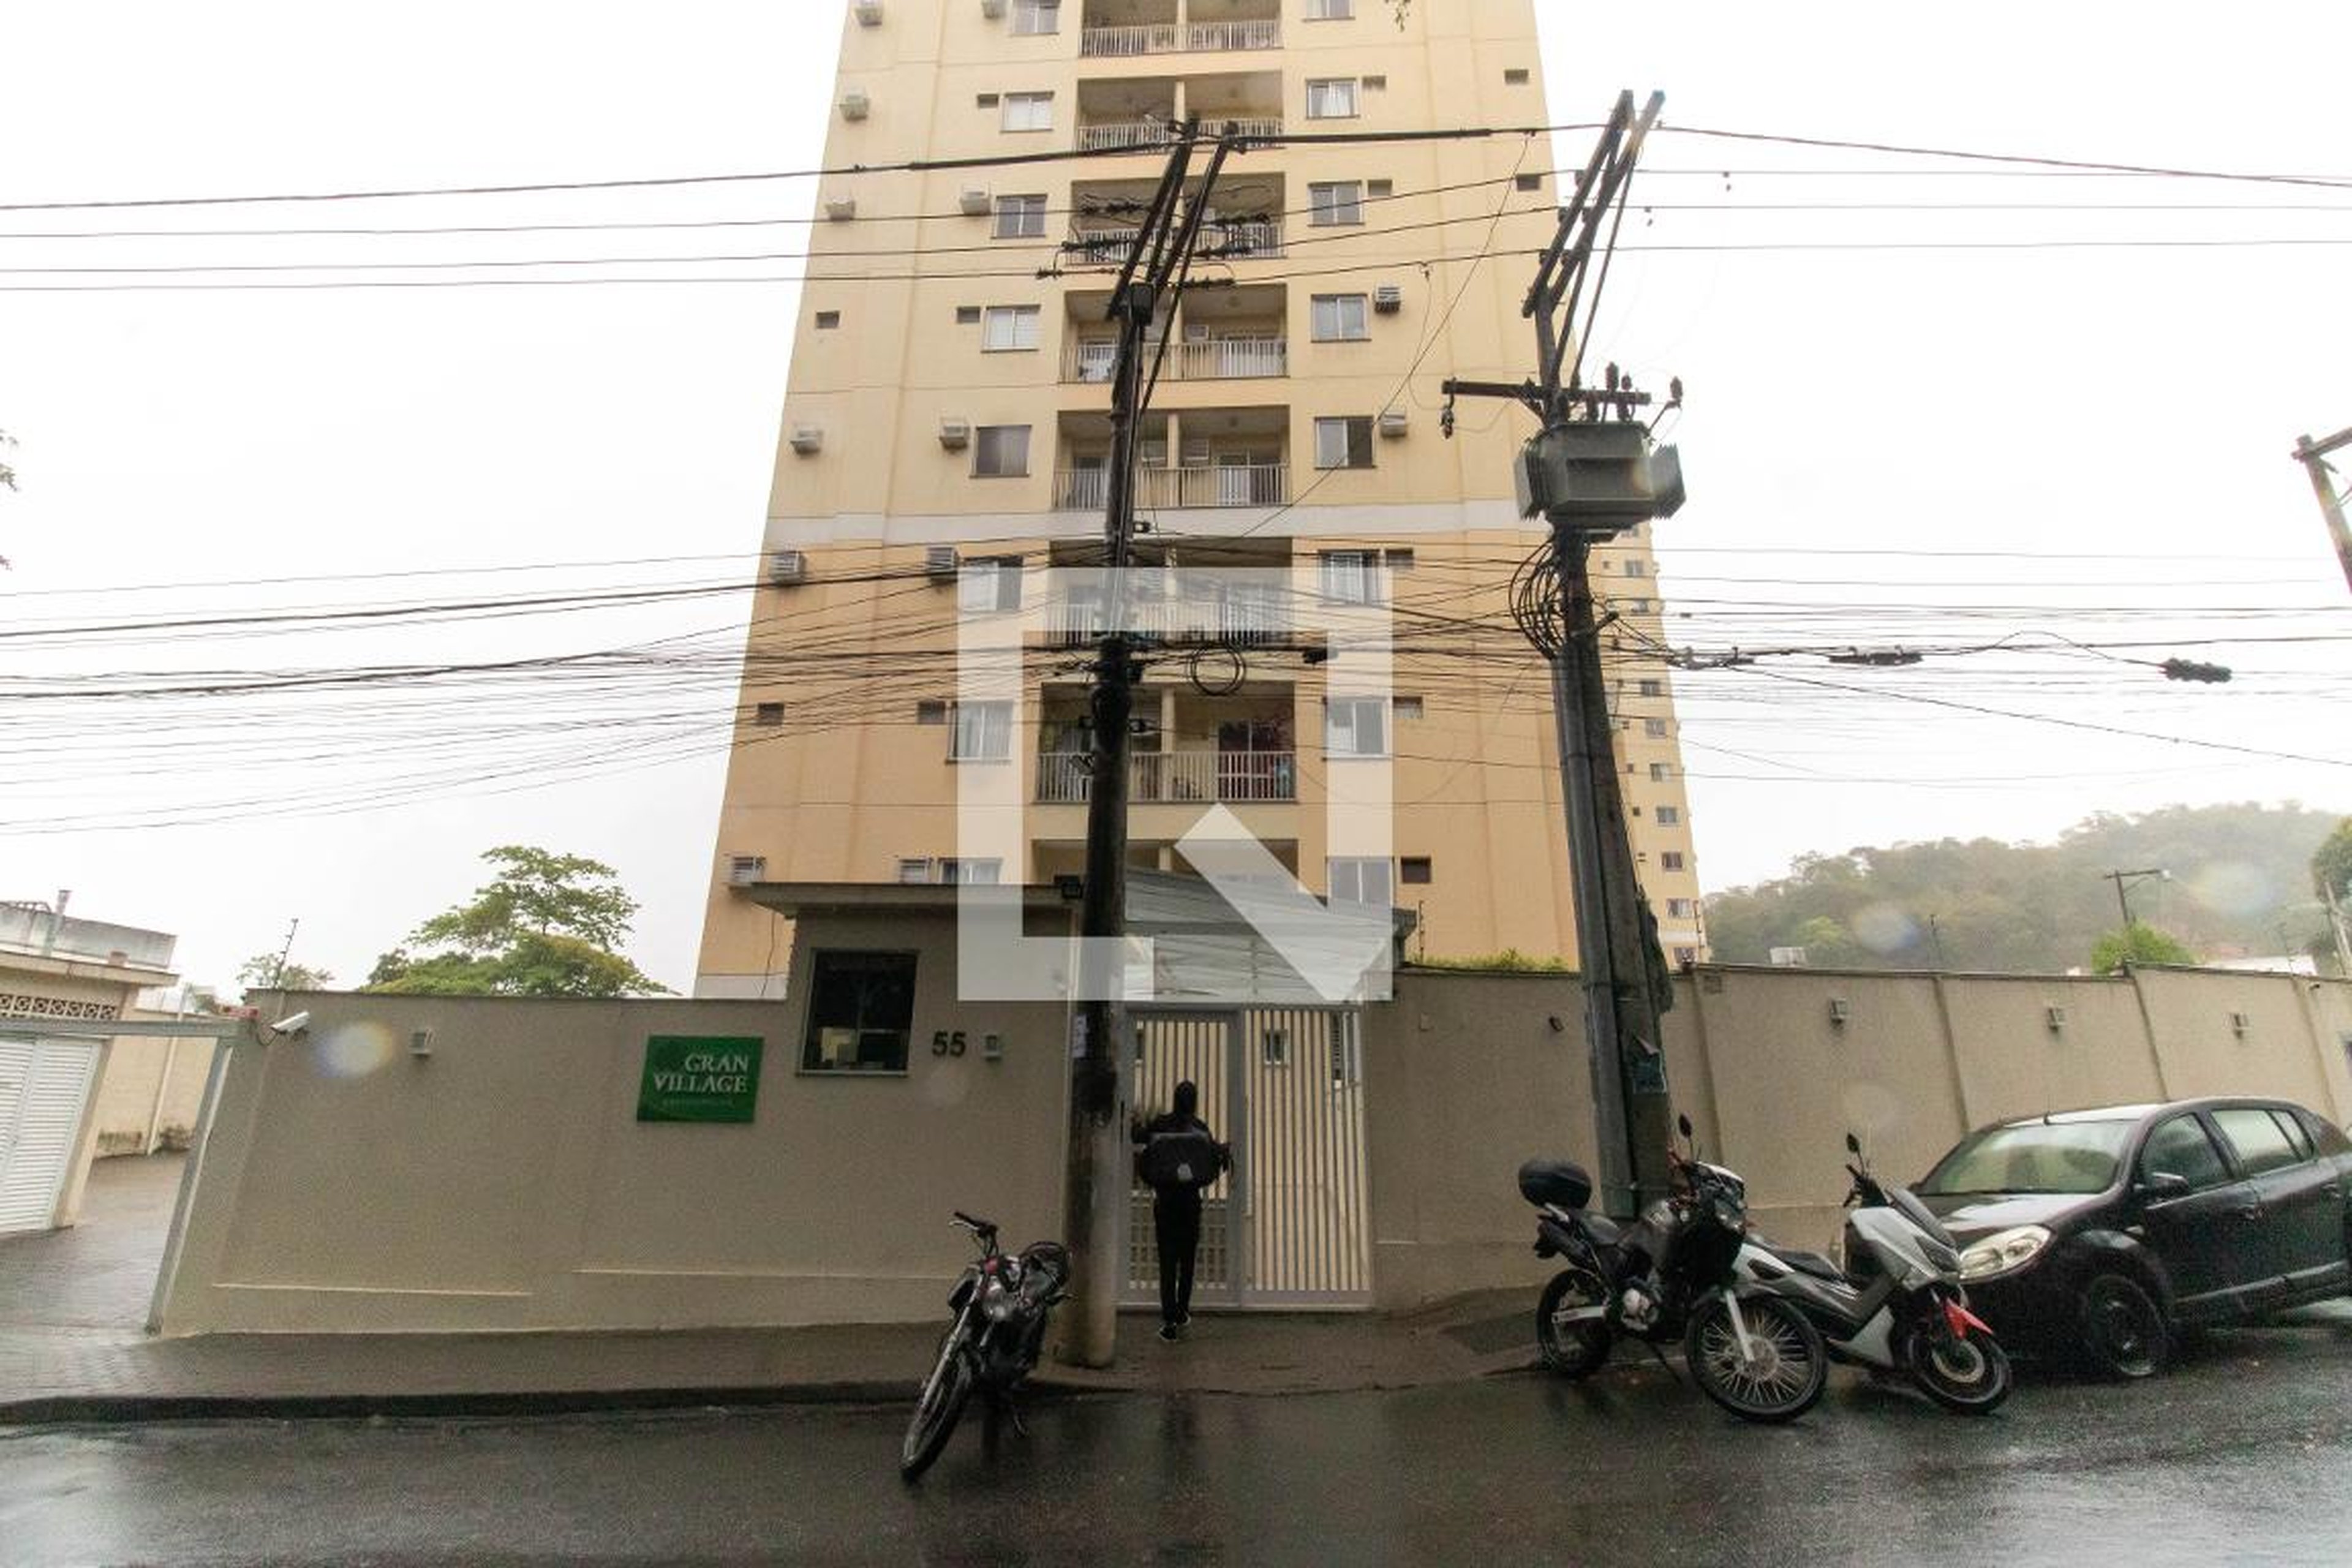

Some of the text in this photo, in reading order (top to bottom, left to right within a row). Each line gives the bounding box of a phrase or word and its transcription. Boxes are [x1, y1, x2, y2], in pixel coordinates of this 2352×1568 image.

[932, 1031, 967, 1057] 55
[684, 1053, 748, 1072] GRAN
[653, 1074, 748, 1092] VILLAGE
